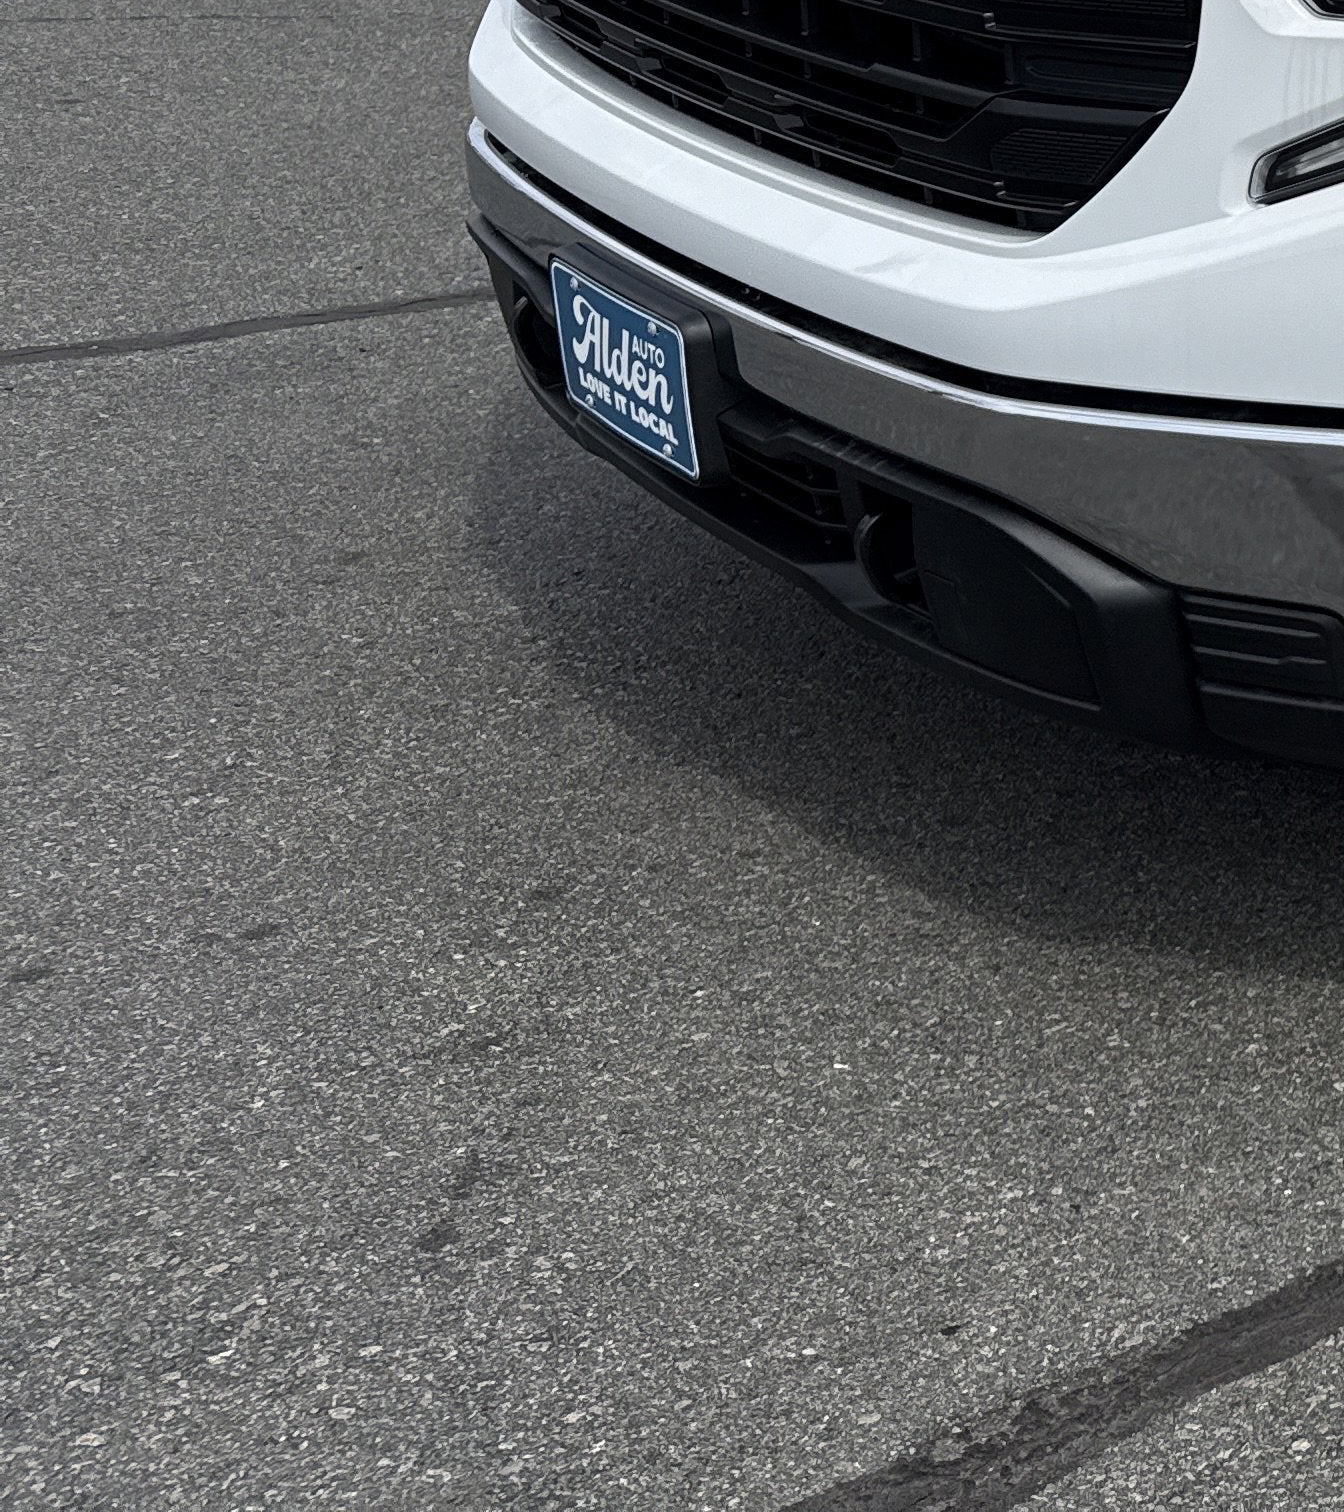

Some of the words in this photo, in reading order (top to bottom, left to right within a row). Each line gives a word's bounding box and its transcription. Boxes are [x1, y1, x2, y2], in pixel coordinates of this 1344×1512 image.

[573, 294, 674, 415] Alden
[632, 335, 665, 369] AUTO
[578, 367, 612, 405] LOVE
[614, 393, 627, 415] IT
[630, 400, 679, 446] LOCAL
